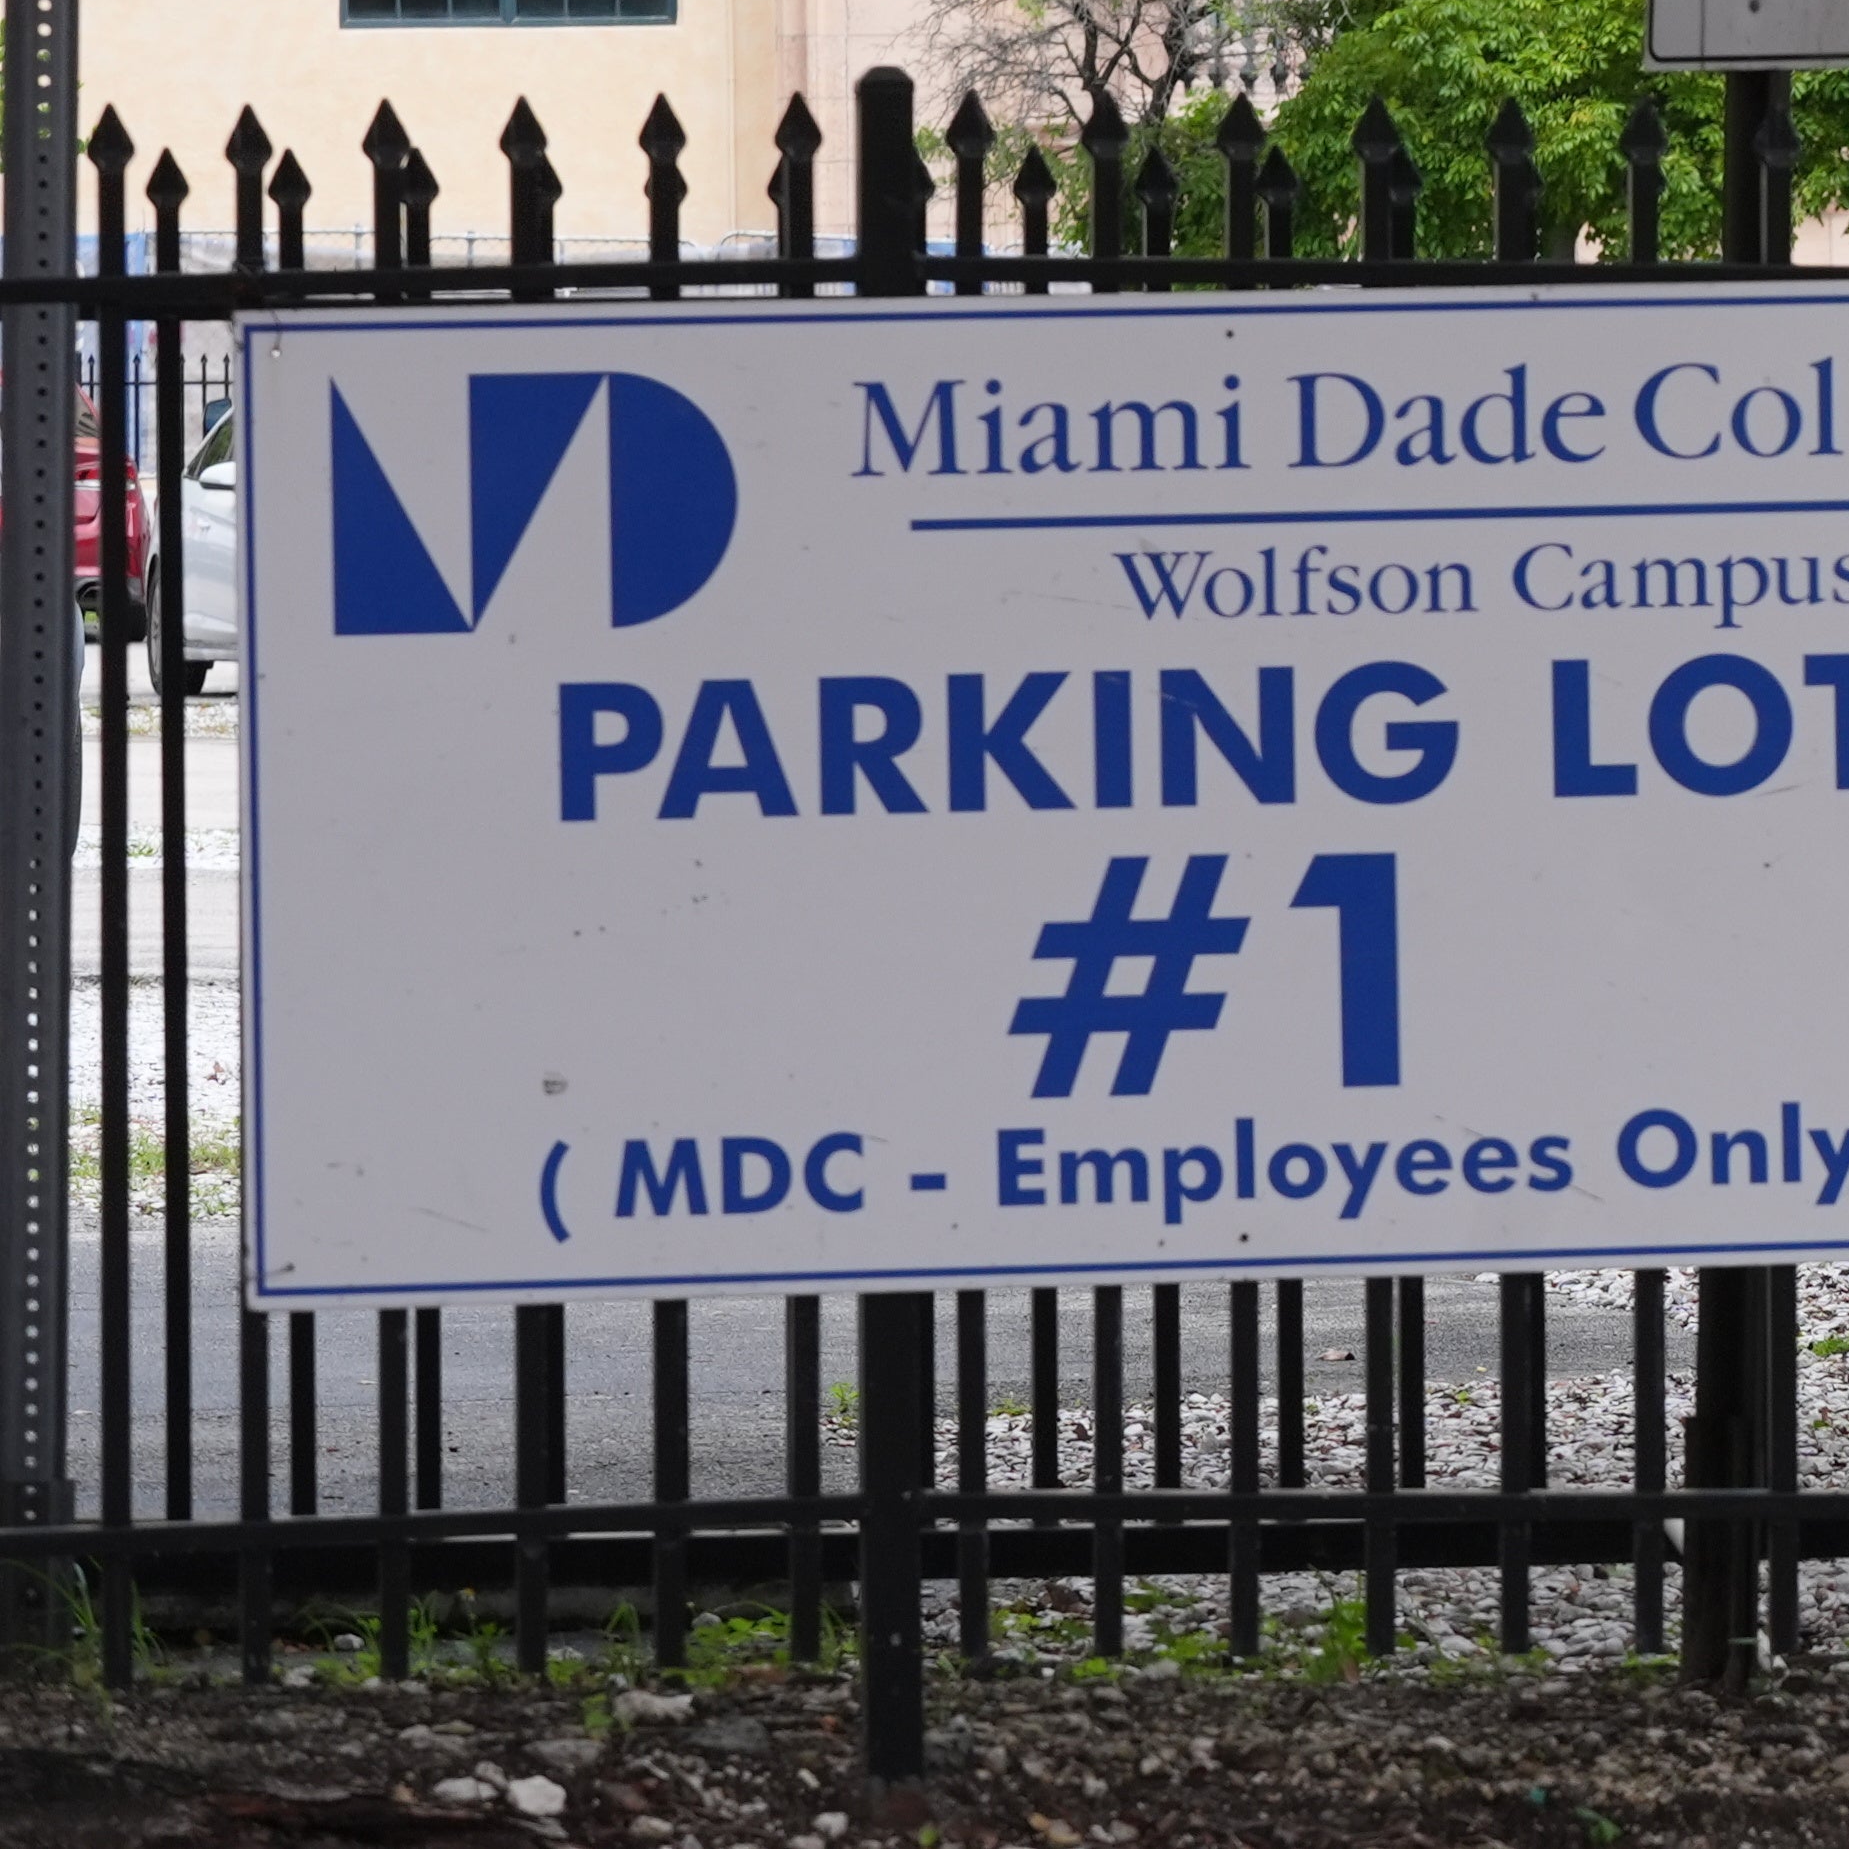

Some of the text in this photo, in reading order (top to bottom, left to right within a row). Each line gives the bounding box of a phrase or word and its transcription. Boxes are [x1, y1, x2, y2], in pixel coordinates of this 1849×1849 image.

[851, 375, 1250, 479] Miami
[1287, 365, 1606, 470] Dade
[1114, 544, 1478, 621] Wolfson
[559, 660, 1461, 822] PARKING
[1006, 851, 1402, 1100] #1
[614, 1131, 866, 1220] MDC
[996, 1115, 1575, 1225] Employees
